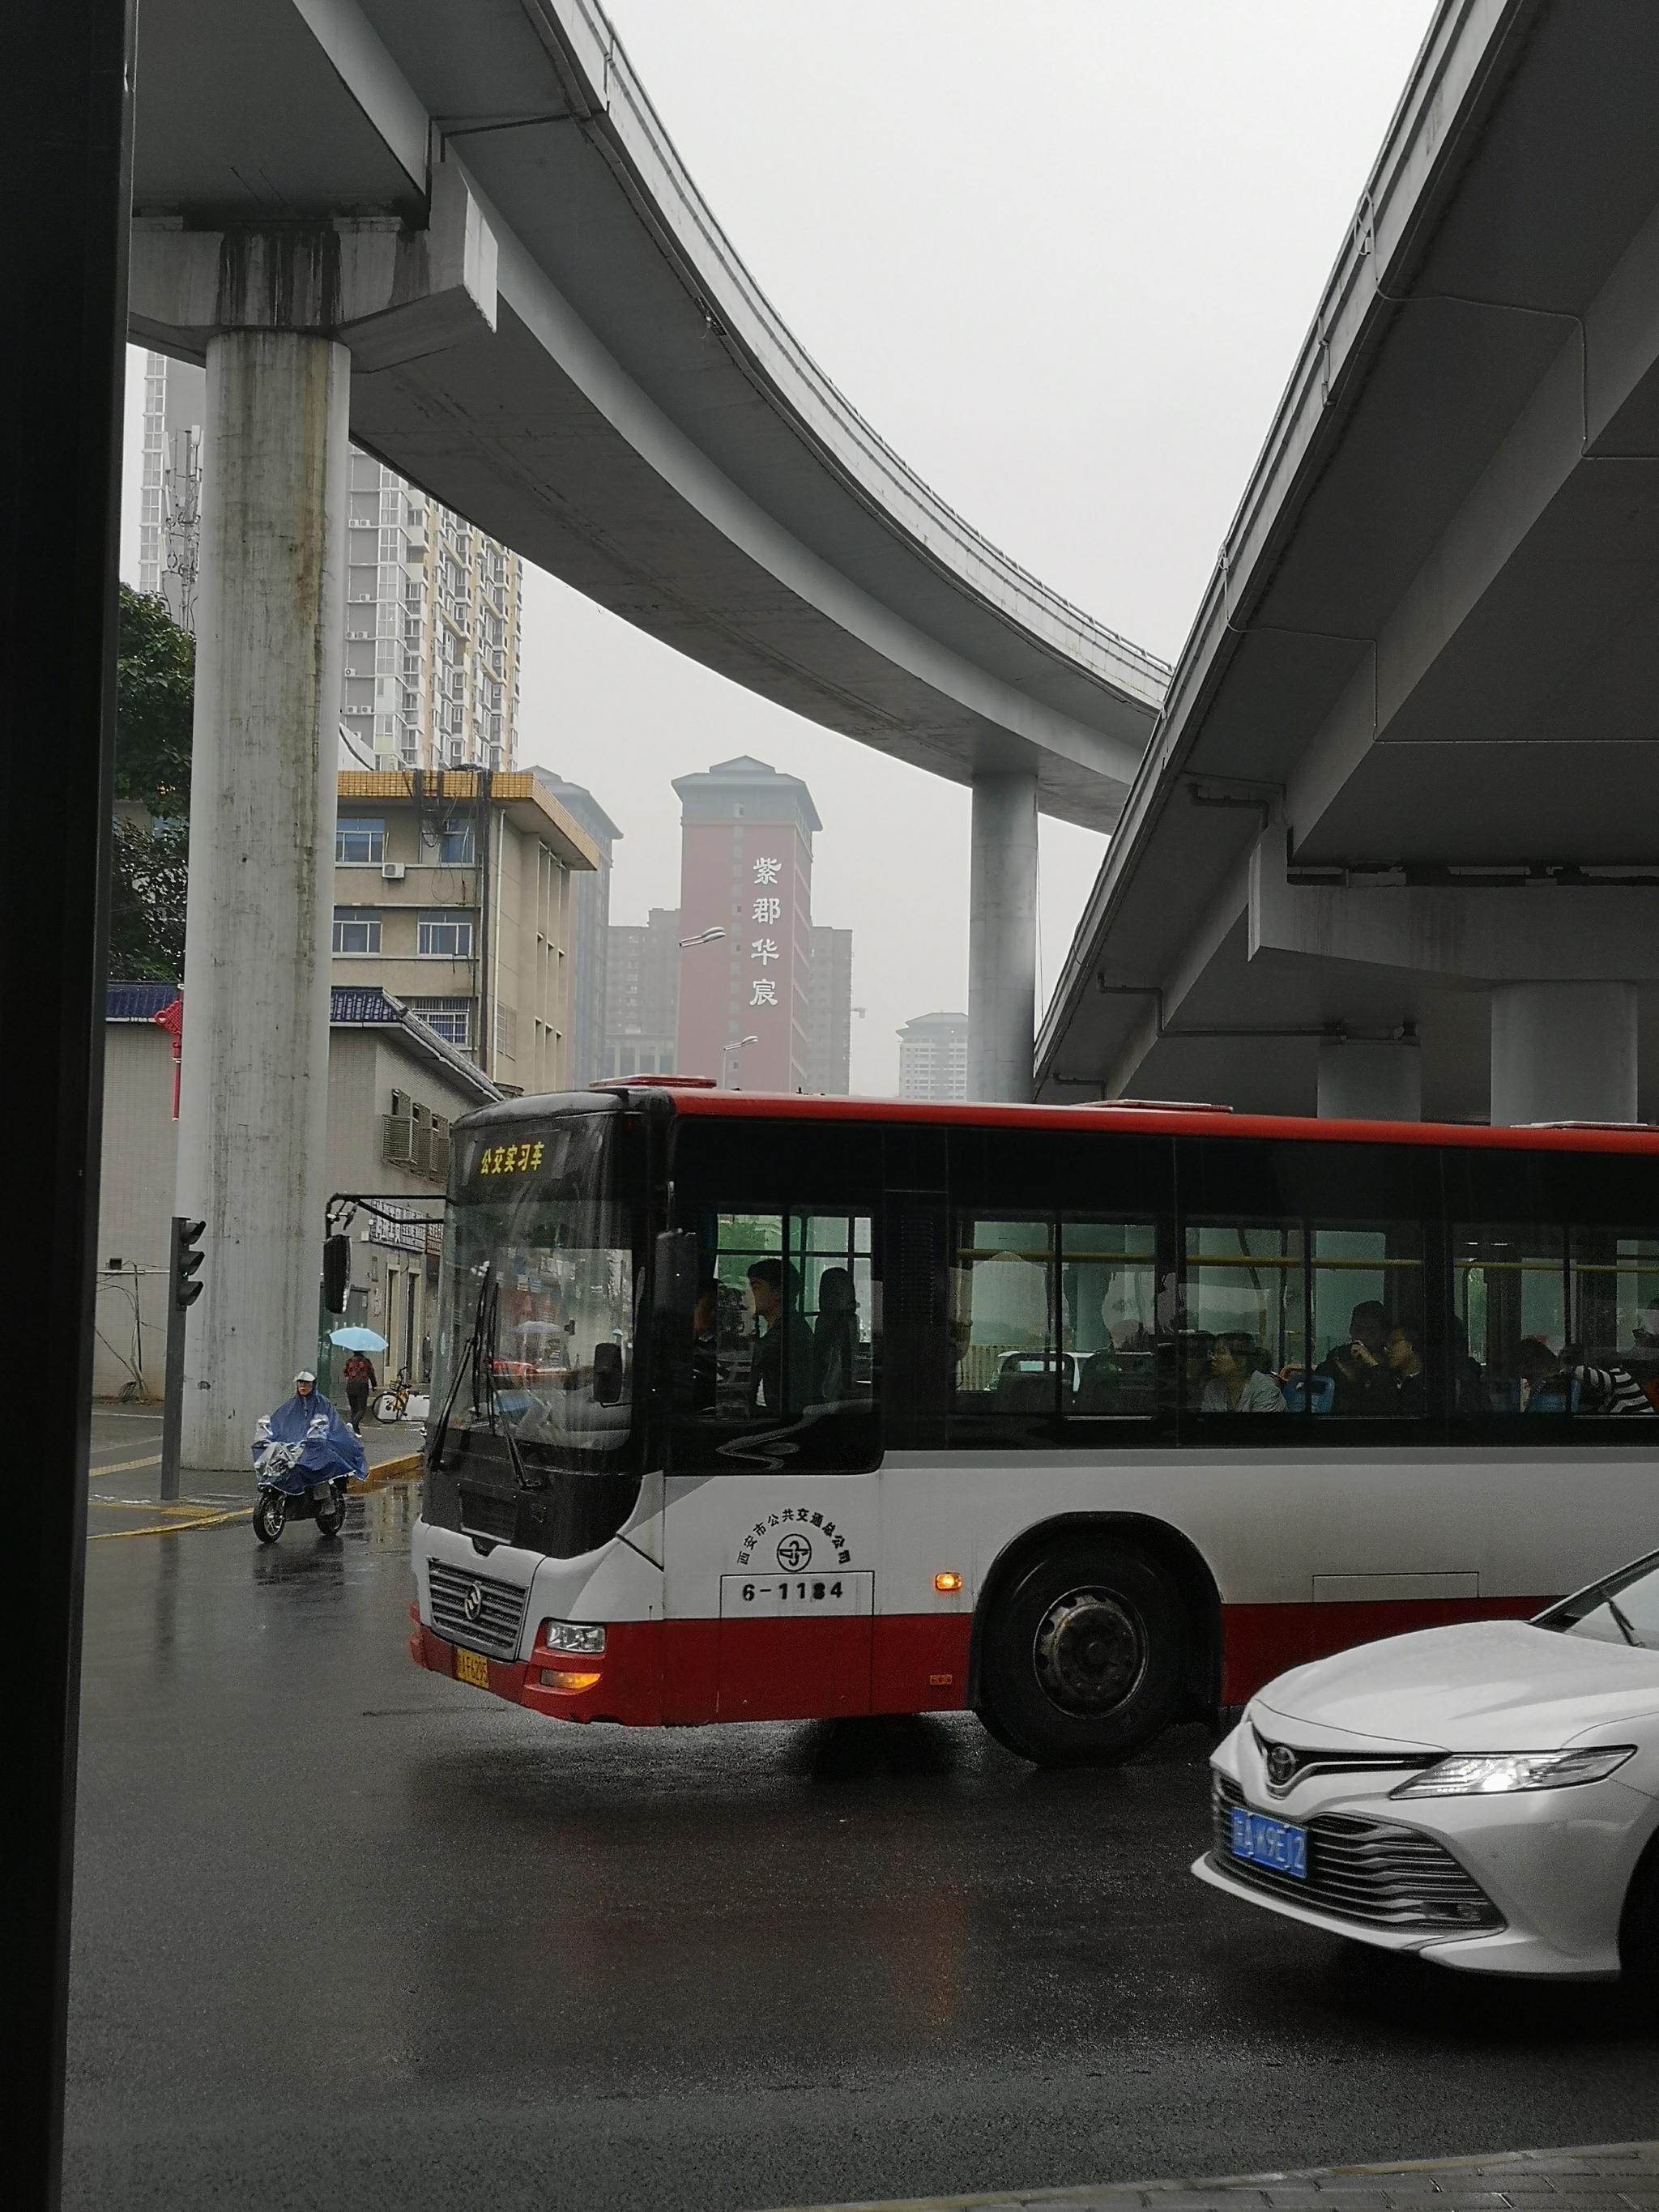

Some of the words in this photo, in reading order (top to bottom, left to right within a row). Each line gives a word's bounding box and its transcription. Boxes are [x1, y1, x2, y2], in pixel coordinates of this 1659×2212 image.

[749, 857, 782, 1006] 紫郡华宸
[481, 1141, 544, 1174] 公交实习车
[737, 1508, 851, 1565] 西安市公共交通总公司
